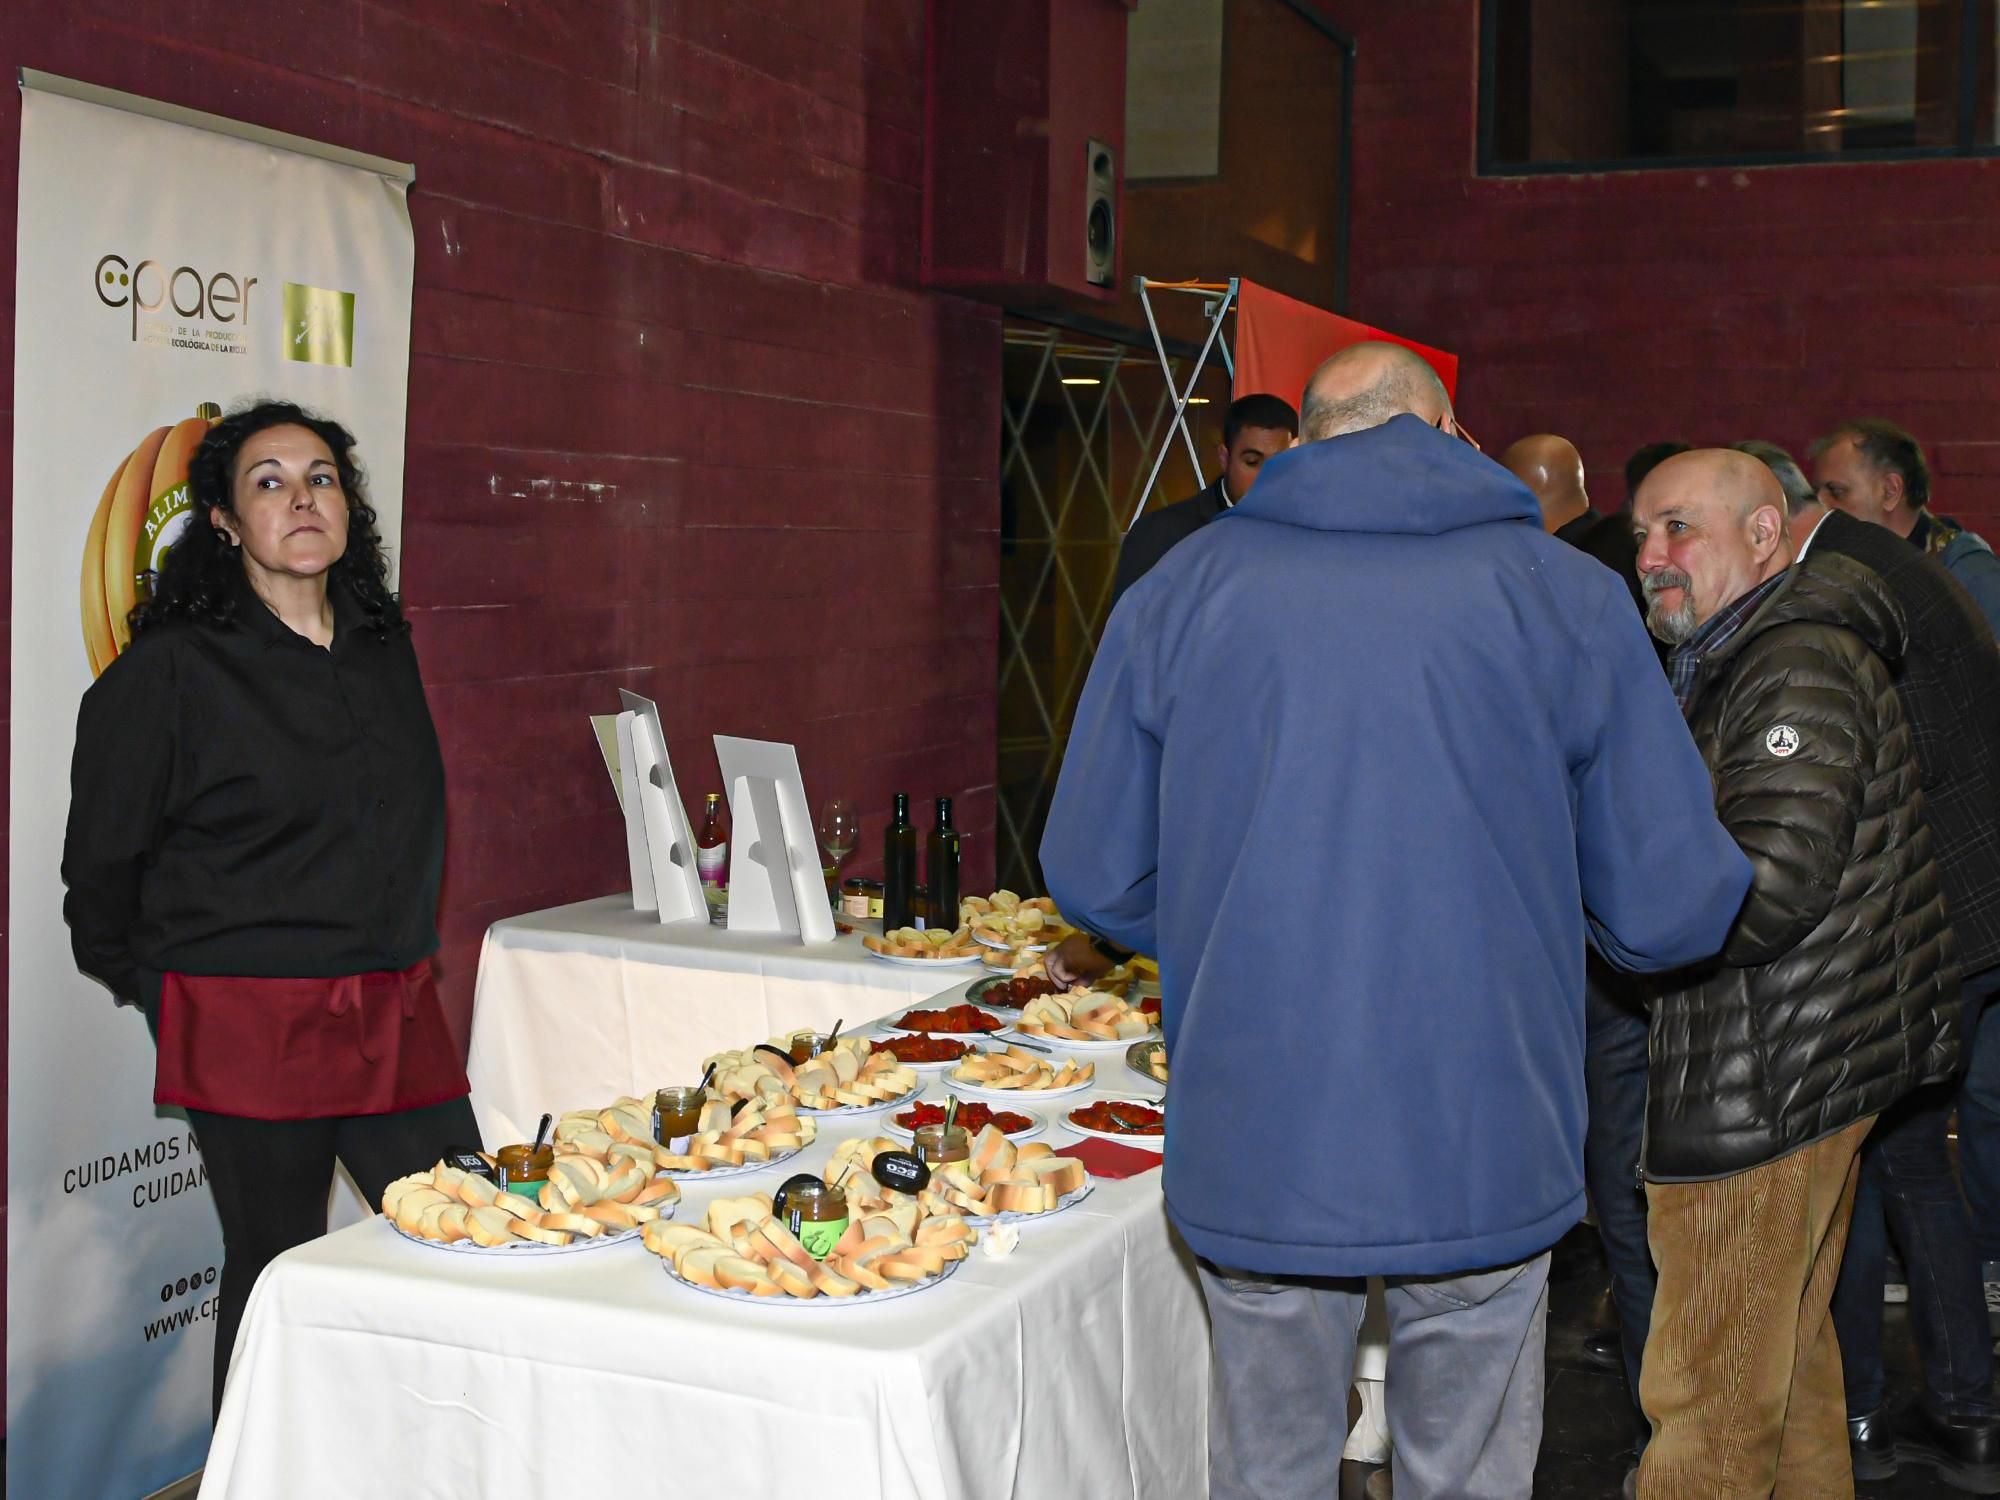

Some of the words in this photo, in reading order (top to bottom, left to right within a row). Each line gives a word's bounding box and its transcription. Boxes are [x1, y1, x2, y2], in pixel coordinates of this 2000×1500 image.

[177, 326, 187, 336] DE
[192, 328, 201, 337] LA
[205, 329, 248, 343] PRODUCC
[171, 338, 210, 350] ECOLÓGICA
[210, 343, 220, 352] DE
[220, 344, 229, 353] LA
[145, 486, 190, 540] ALIM
[63, 1136, 180, 1194] CUIDAMOS
[459, 1157, 482, 1167] ECO
[886, 1163, 918, 1178] ECO
